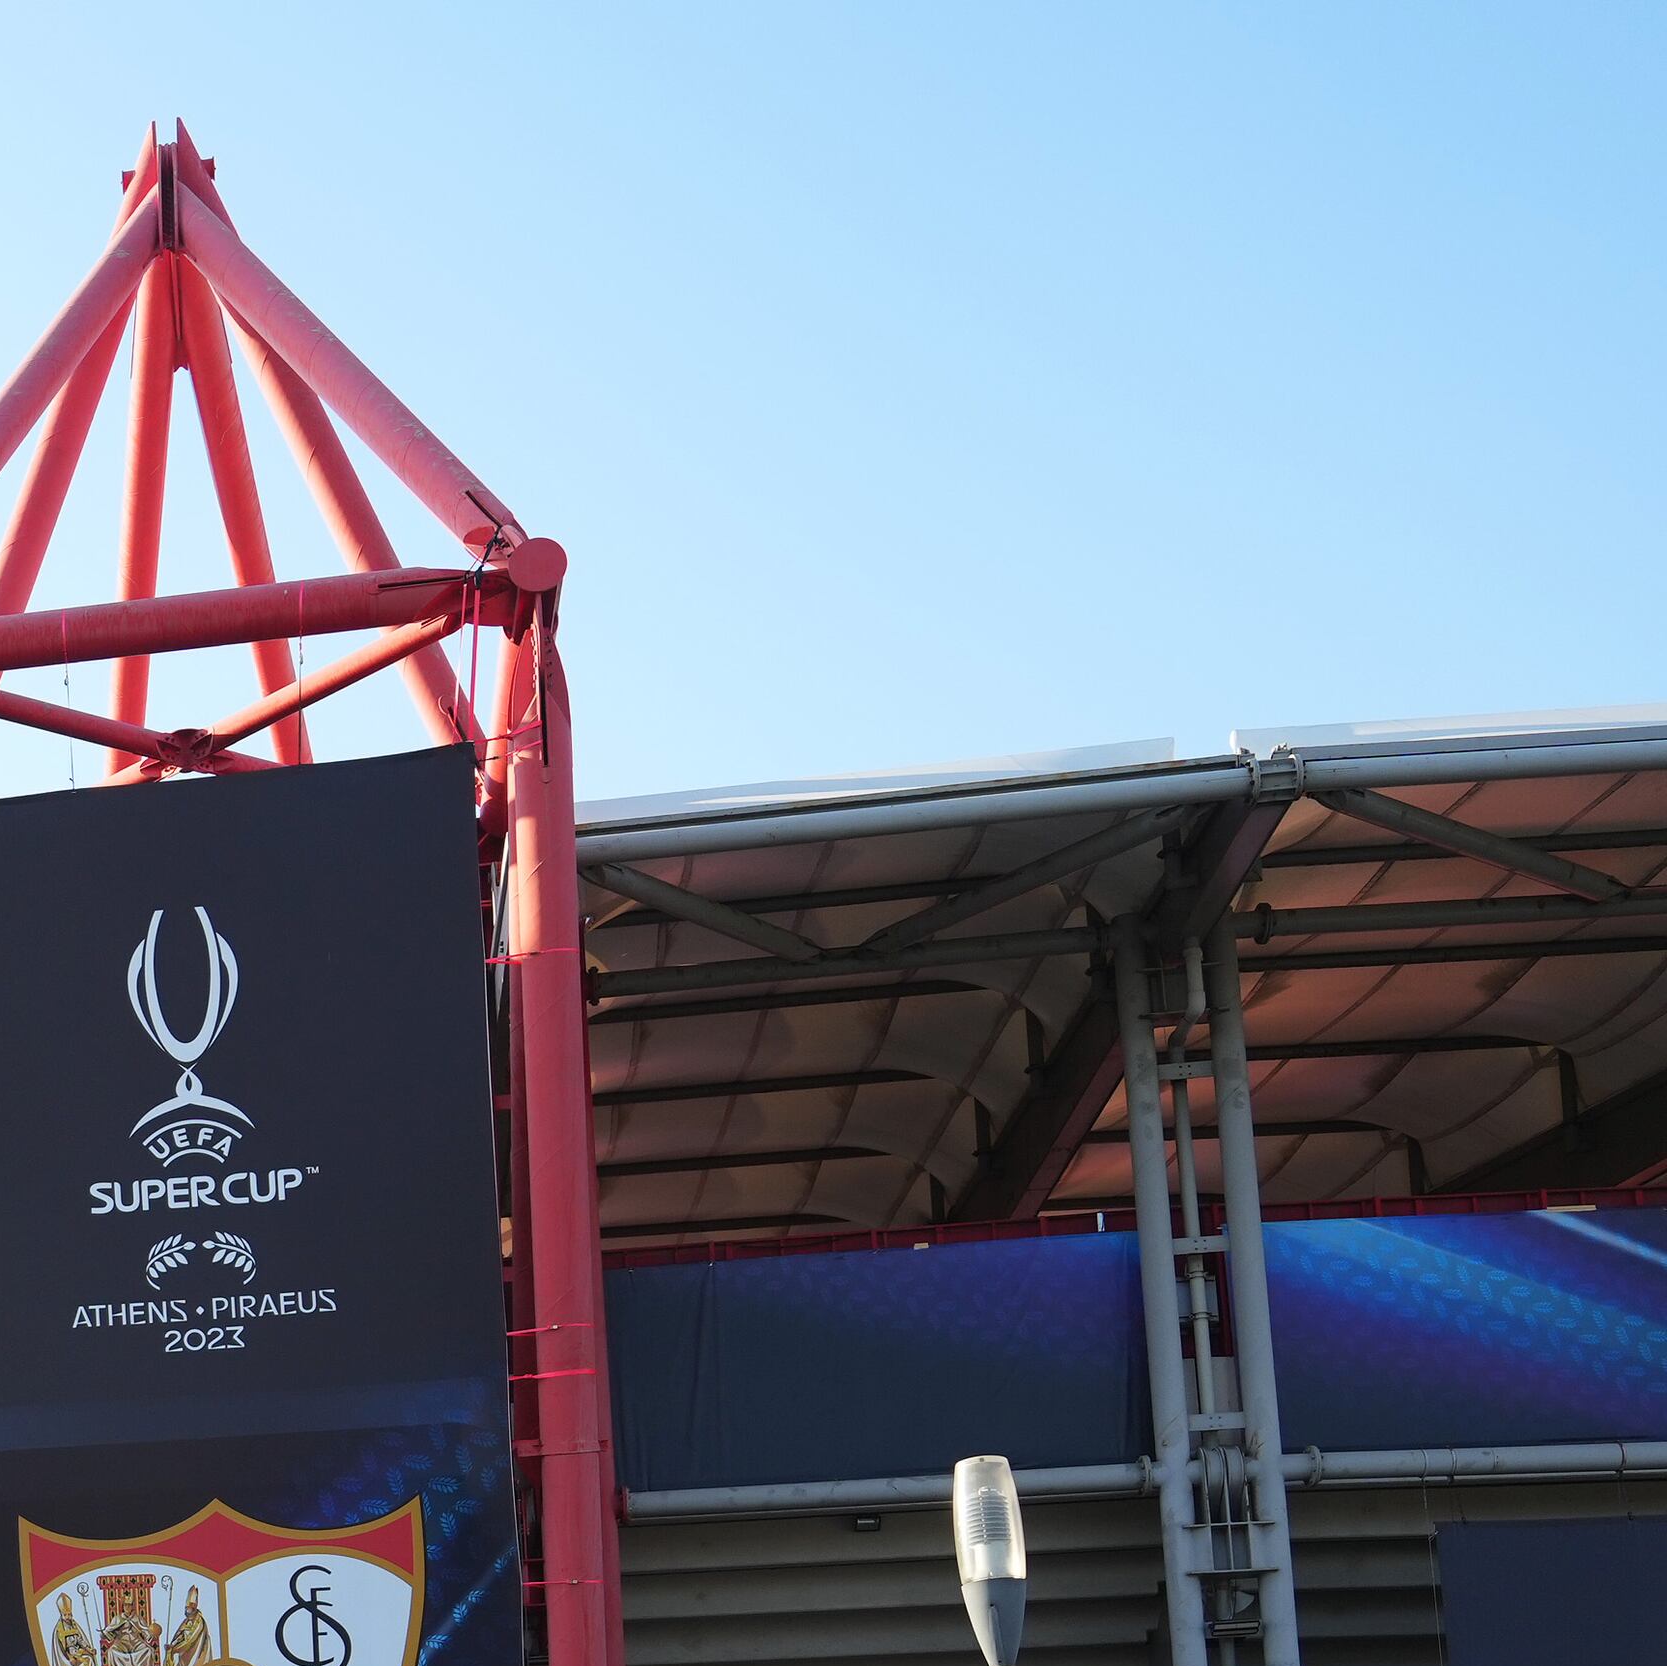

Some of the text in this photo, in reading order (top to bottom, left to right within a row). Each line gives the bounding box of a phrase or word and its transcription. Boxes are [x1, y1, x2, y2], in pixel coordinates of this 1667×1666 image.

[148, 1126, 233, 1159] UEFA
[72, 1288, 337, 1329] ATHENS PIRAEUS
[164, 1325, 246, 1353] 2023
